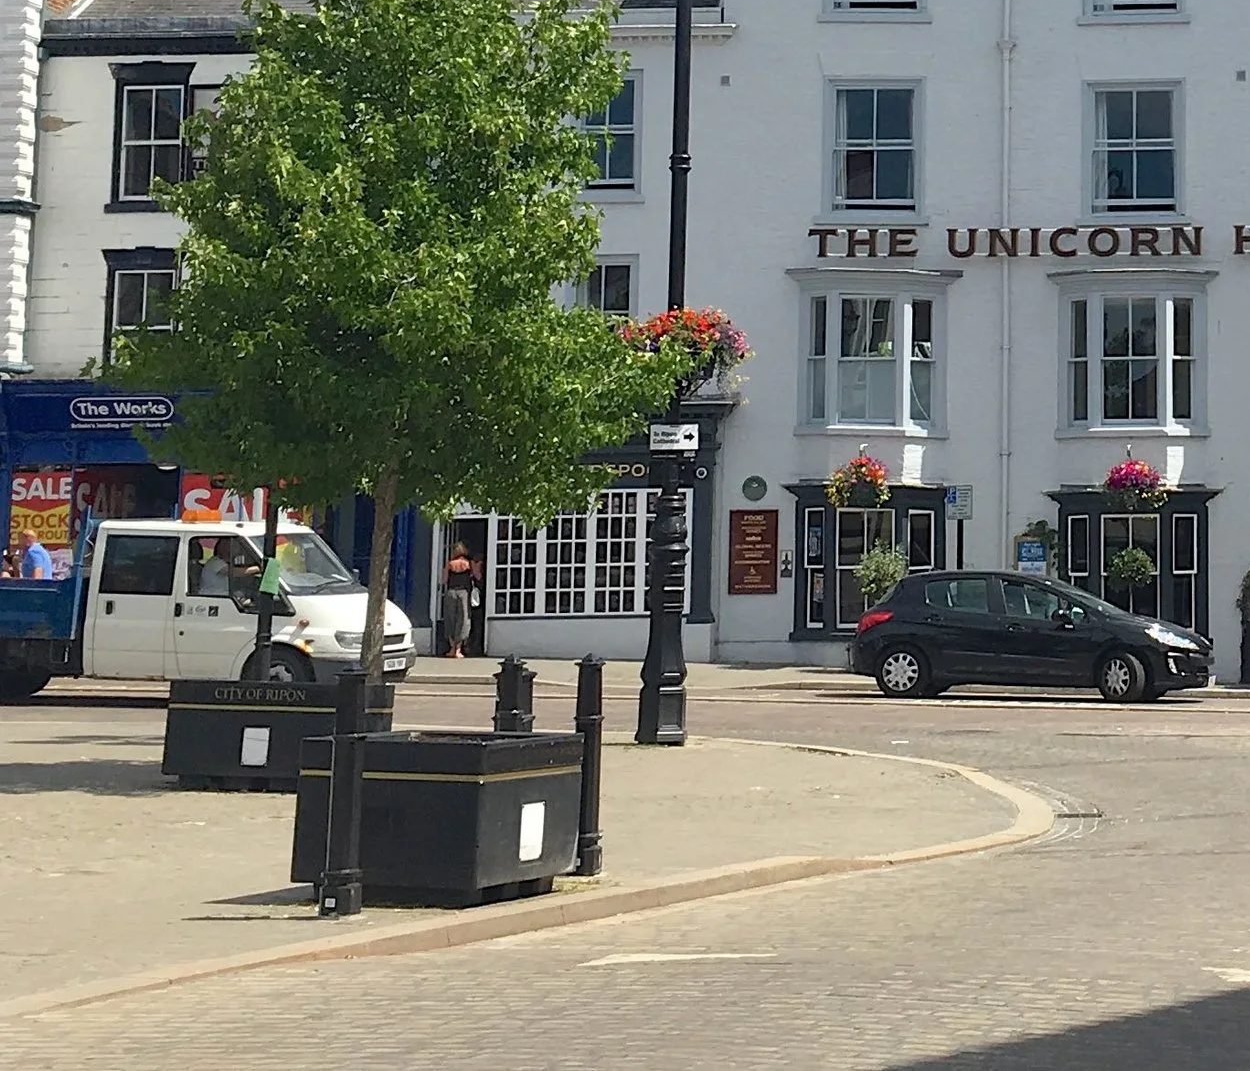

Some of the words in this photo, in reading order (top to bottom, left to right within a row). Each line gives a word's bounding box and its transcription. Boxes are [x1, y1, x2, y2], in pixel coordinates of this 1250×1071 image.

[808, 228, 919, 258] THE
[946, 225, 1203, 259] UNICORN
[77, 402, 109, 416] The
[113, 401, 167, 415] Works
[12, 477, 73, 501] SALE
[11, 513, 70, 530] STOCK
[215, 687, 243, 700] CITY
[246, 688, 262, 700] OF
[266, 689, 306, 702] RIPON
